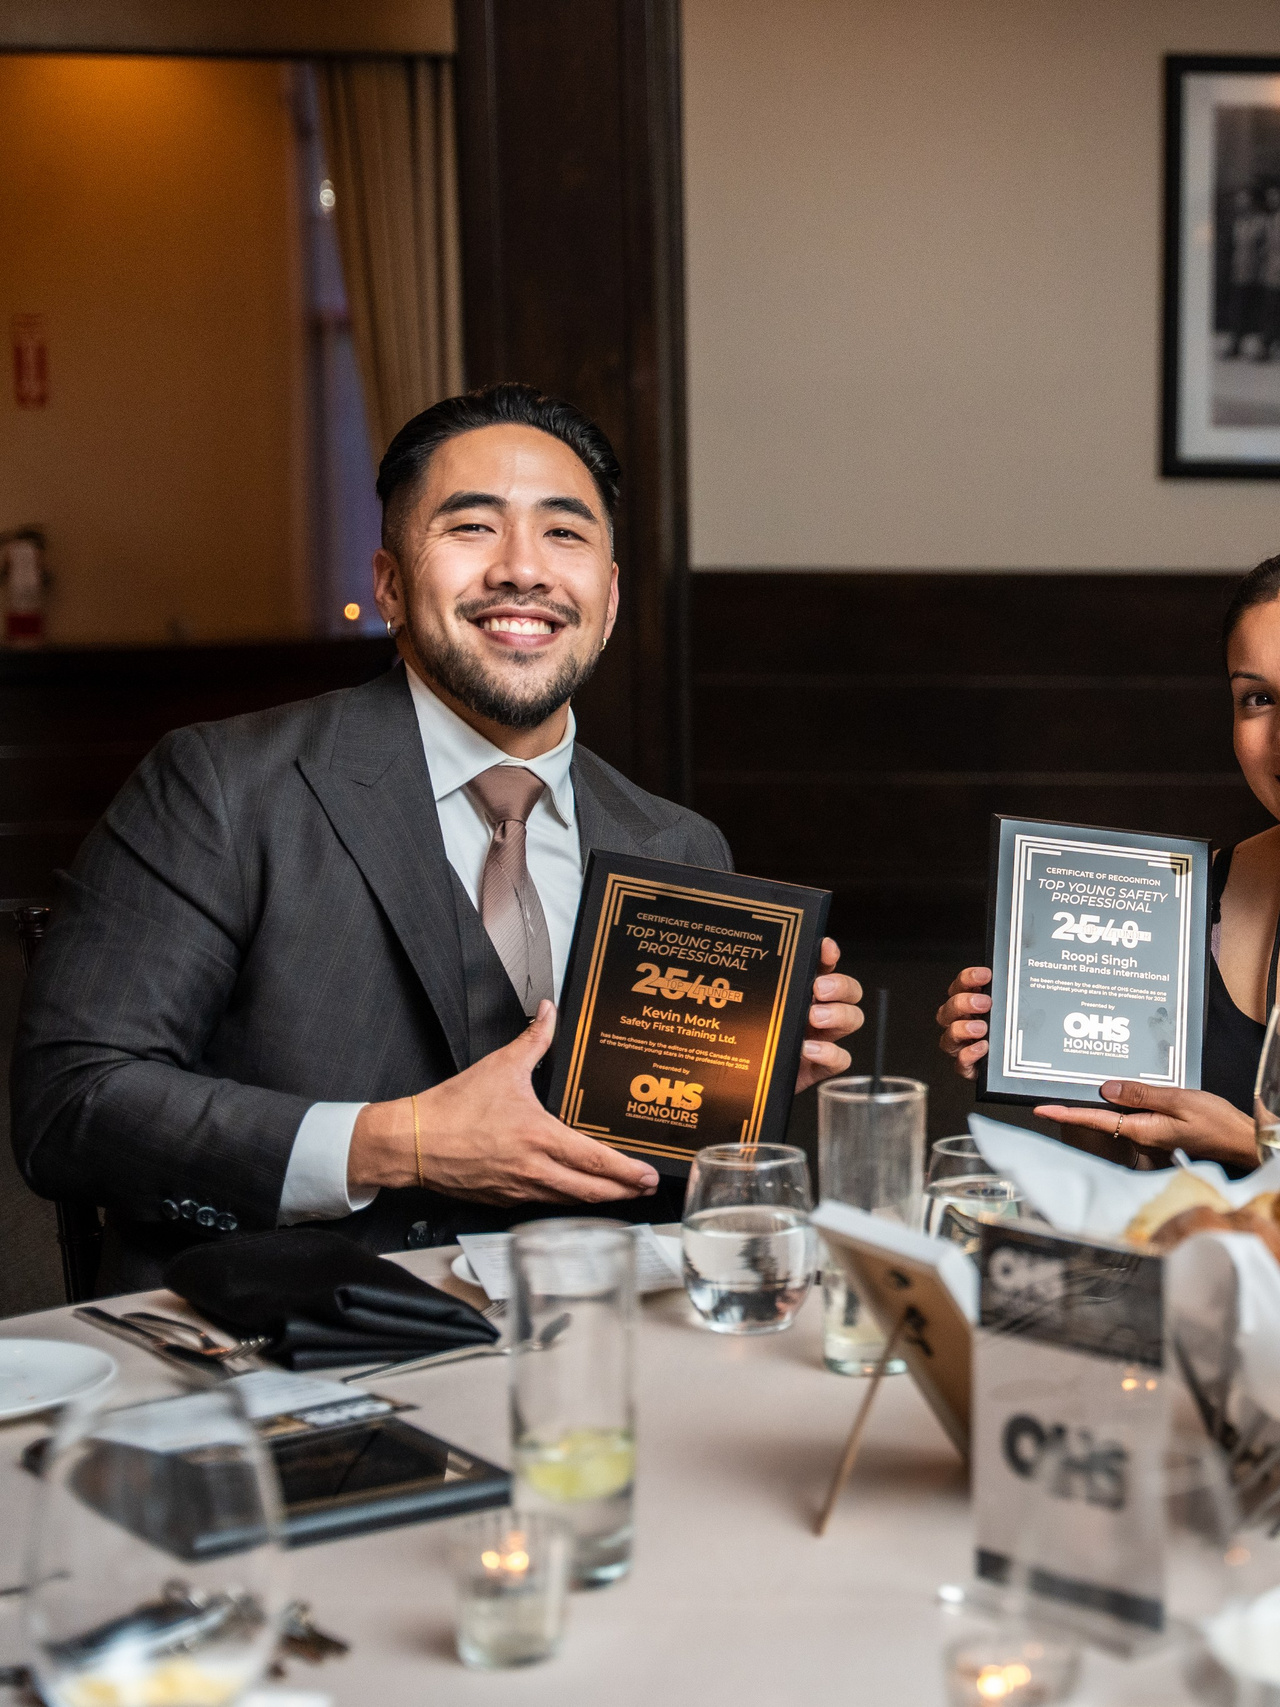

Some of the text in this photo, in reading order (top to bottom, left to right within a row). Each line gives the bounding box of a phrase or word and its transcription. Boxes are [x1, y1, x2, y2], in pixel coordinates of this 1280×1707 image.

[1046, 867, 1094, 878] CERTIFICATE
[1108, 874, 1160, 886] RECOGNITION
[1038, 878, 1168, 902] TOP YOUNG SAFETY
[1051, 892, 1152, 913] PROFESSIONAL
[636, 912, 689, 928] CERTIFICATE
[704, 925, 762, 941] RECOGNITION
[626, 924, 768, 960] TOP YOUNG SAFETY
[637, 940, 747, 970] PROFESSIONAL
[1061, 950, 1137, 969] Roopi Singh
[1028, 958, 1169, 981] Restaurant Brands International
[642, 1005, 720, 1030] Kevin Mork
[1063, 1012, 1130, 1042] OHS
[620, 1016, 737, 1044] Safety First Training Ltd.
[617, 1041, 643, 1050] brightest
[695, 1056, 725, 1066] profession
[708, 1052, 731, 1060] Canada
[1064, 1037, 1129, 1054] HONOURS
[652, 1062, 682, 1072] Presented
[630, 1074, 705, 1110] OHS
[625, 1112, 653, 1121] CELEBRATING
[627, 1101, 698, 1123] HONOURS
